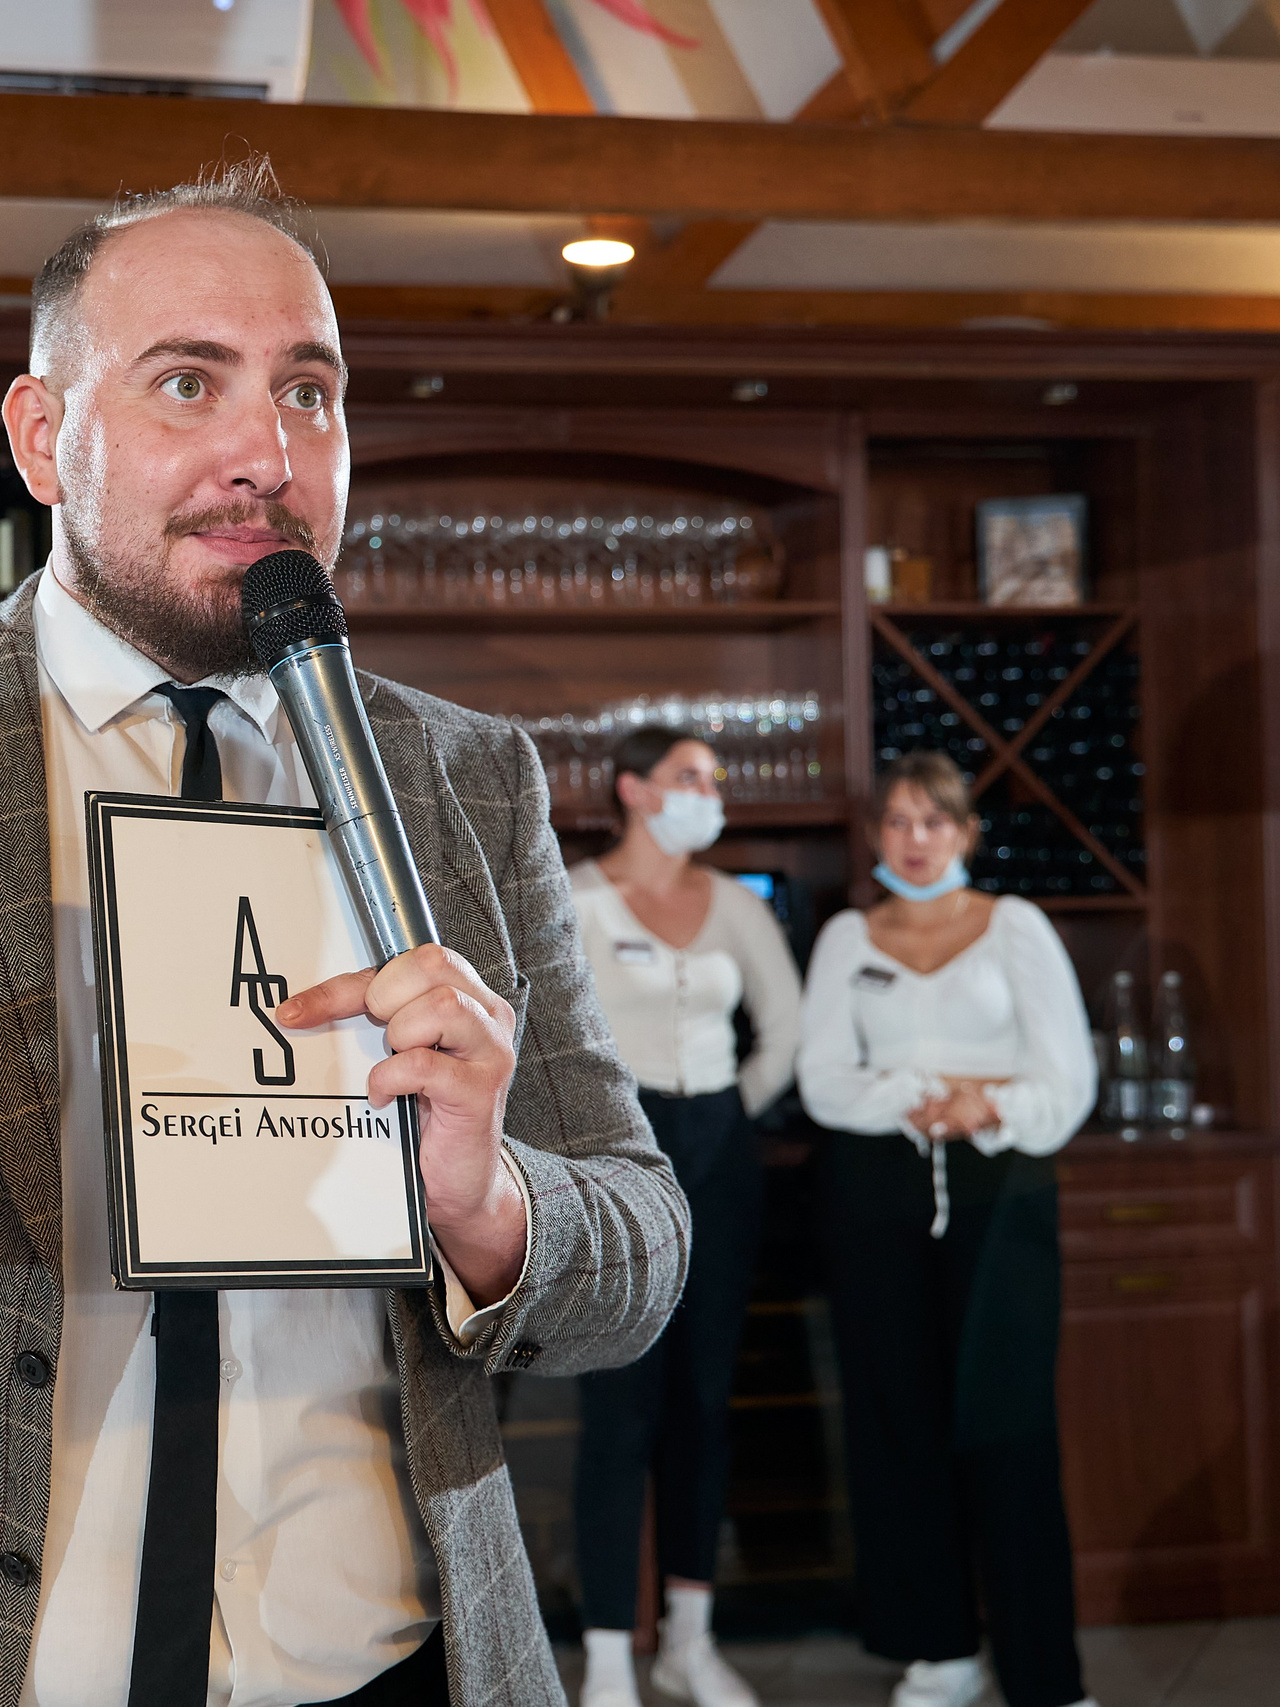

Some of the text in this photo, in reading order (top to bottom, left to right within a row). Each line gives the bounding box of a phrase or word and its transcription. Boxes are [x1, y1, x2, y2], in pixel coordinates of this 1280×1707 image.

[324, 724, 358, 809] SENNHEISER XS WIRELESS
